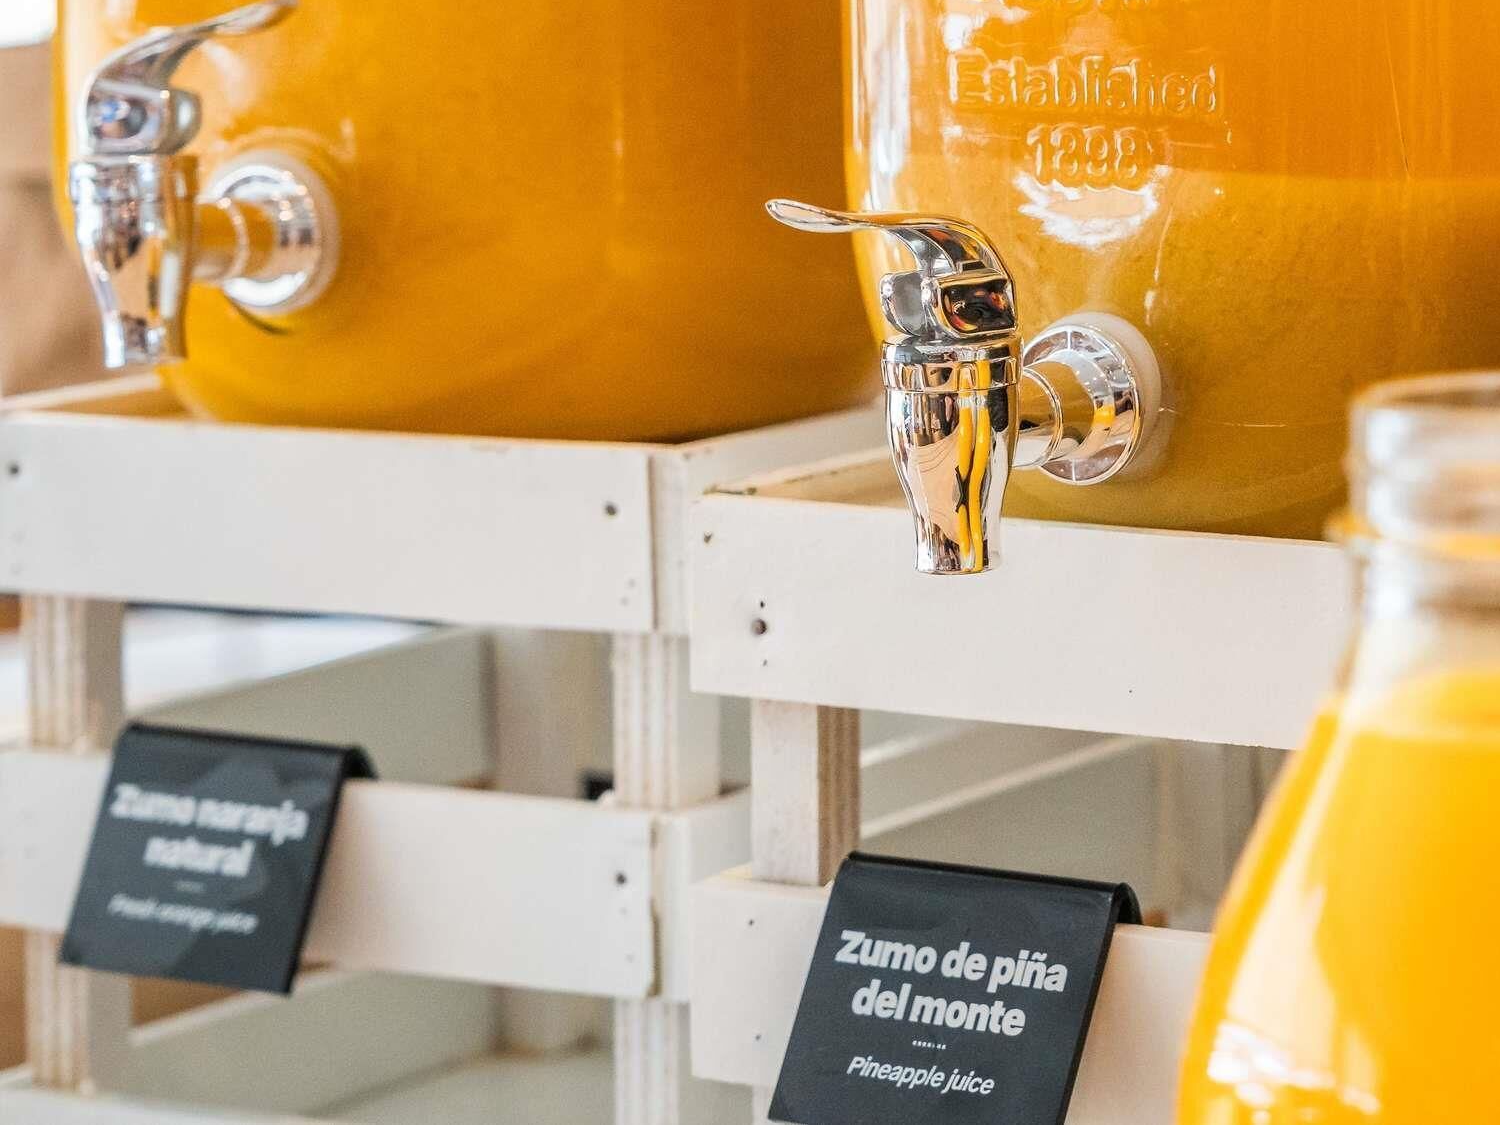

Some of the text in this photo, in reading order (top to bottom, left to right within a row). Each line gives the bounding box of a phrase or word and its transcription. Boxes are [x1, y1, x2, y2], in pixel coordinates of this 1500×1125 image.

[946, 49, 1222, 115] Established
[835, 929, 1069, 994] Zumo de piña
[851, 979, 1027, 1037] del monte
[846, 1055, 996, 1096] Pineapple juice
